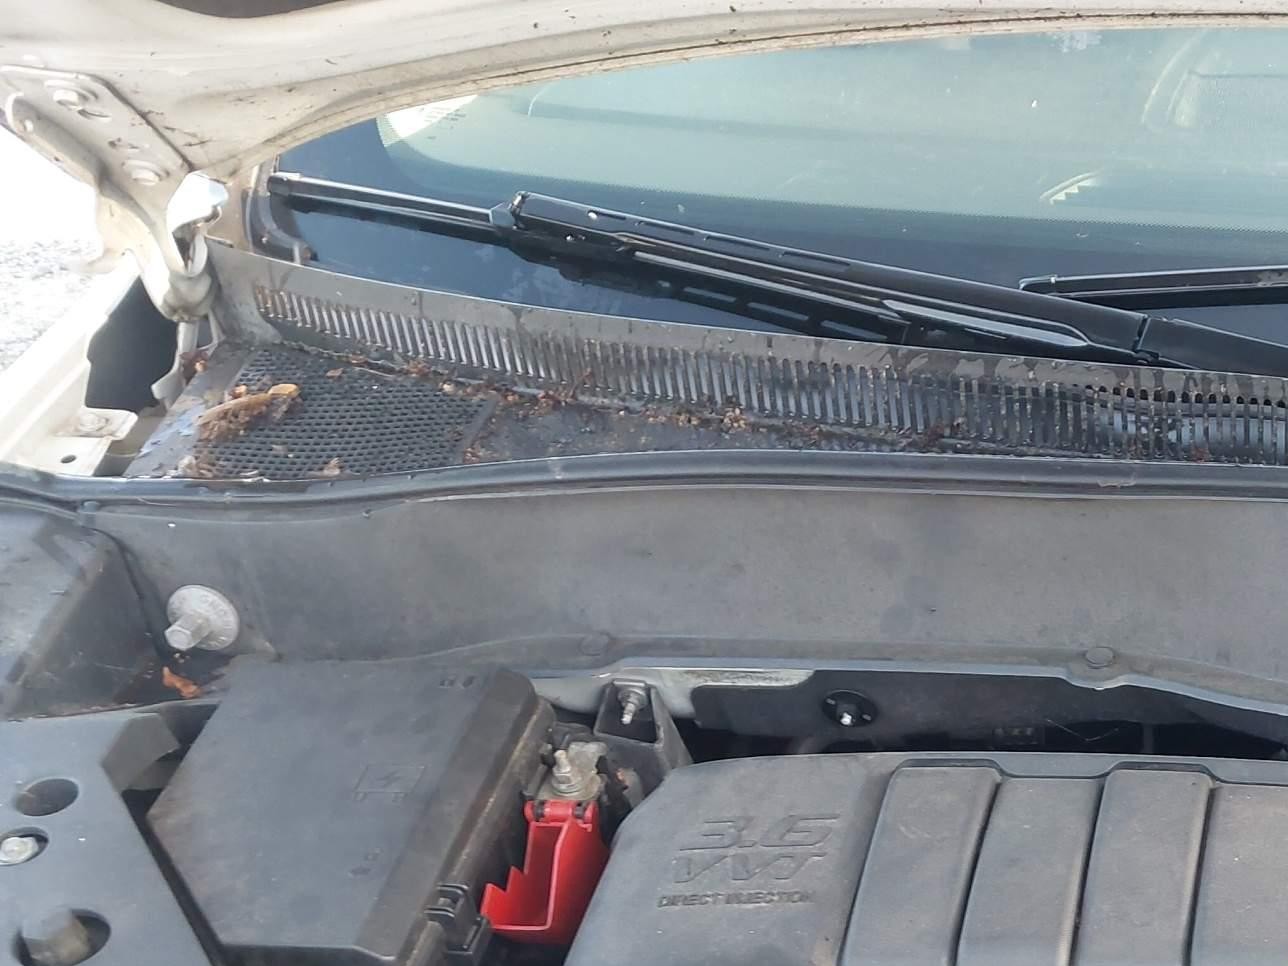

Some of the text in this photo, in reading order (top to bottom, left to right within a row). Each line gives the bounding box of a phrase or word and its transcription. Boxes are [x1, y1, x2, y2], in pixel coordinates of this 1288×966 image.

[679, 813, 841, 852] 3.6
[672, 852, 828, 884] VVT
[657, 892, 724, 908] DIRECT
